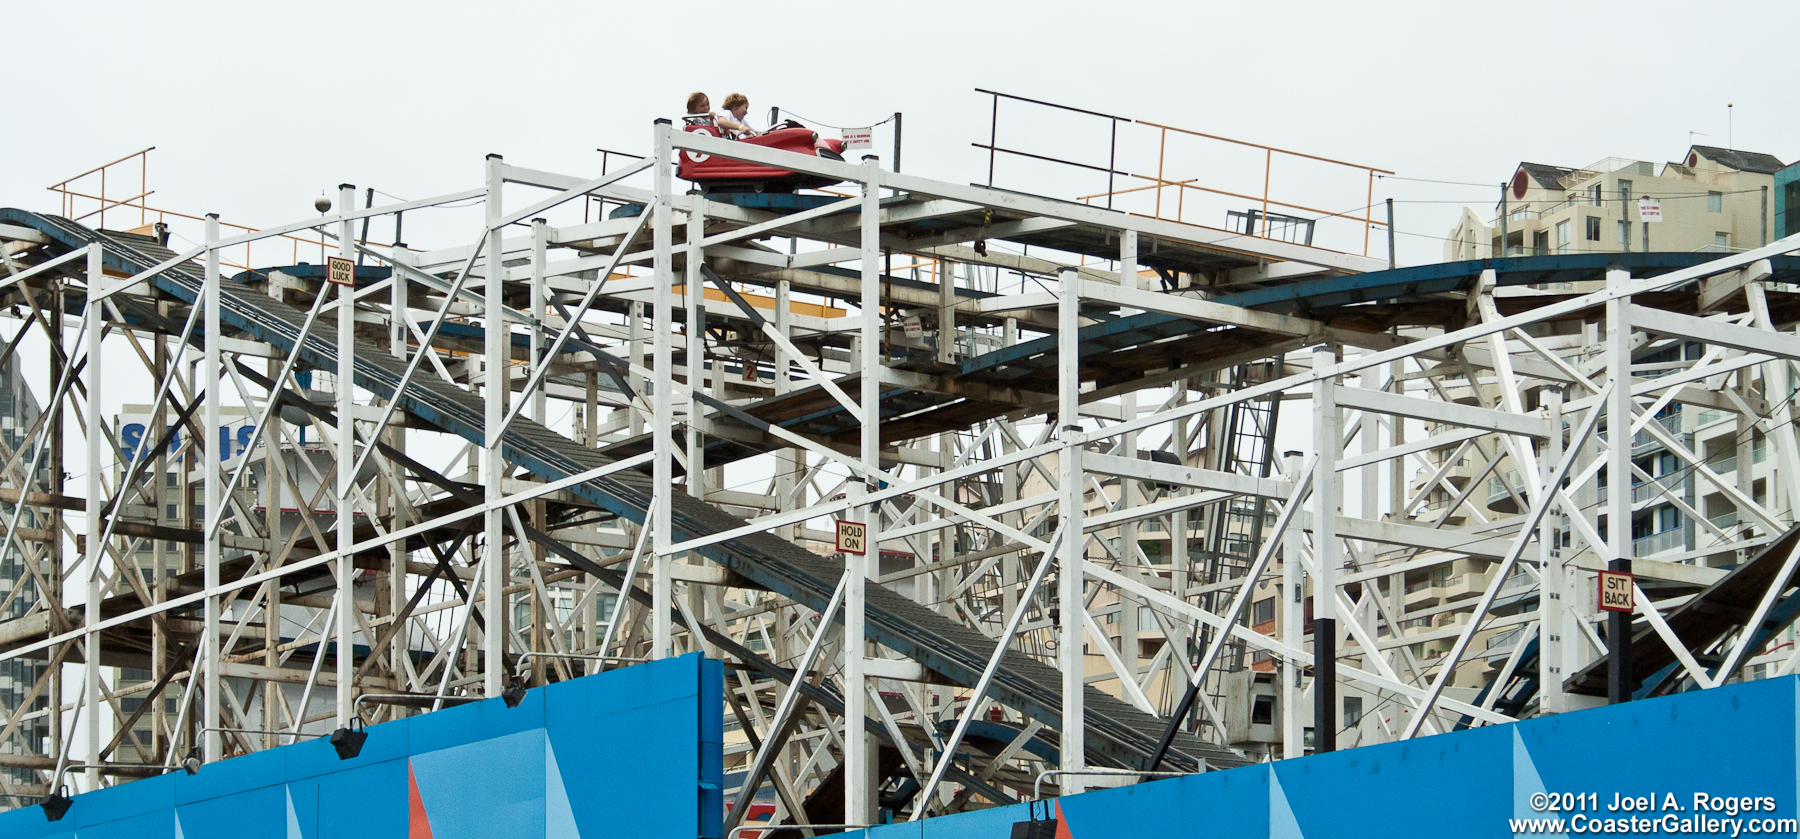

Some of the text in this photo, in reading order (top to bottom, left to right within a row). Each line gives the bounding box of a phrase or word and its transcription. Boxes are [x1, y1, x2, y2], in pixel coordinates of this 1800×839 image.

[332, 261, 351, 271] GOOD
[332, 271, 350, 281] LUCK
[746, 365, 754, 380] 2
[841, 525, 862, 537] HOLD
[845, 538, 859, 549] ON
[1607, 577, 1627, 590] SIT
[1604, 591, 1630, 606] BACK
